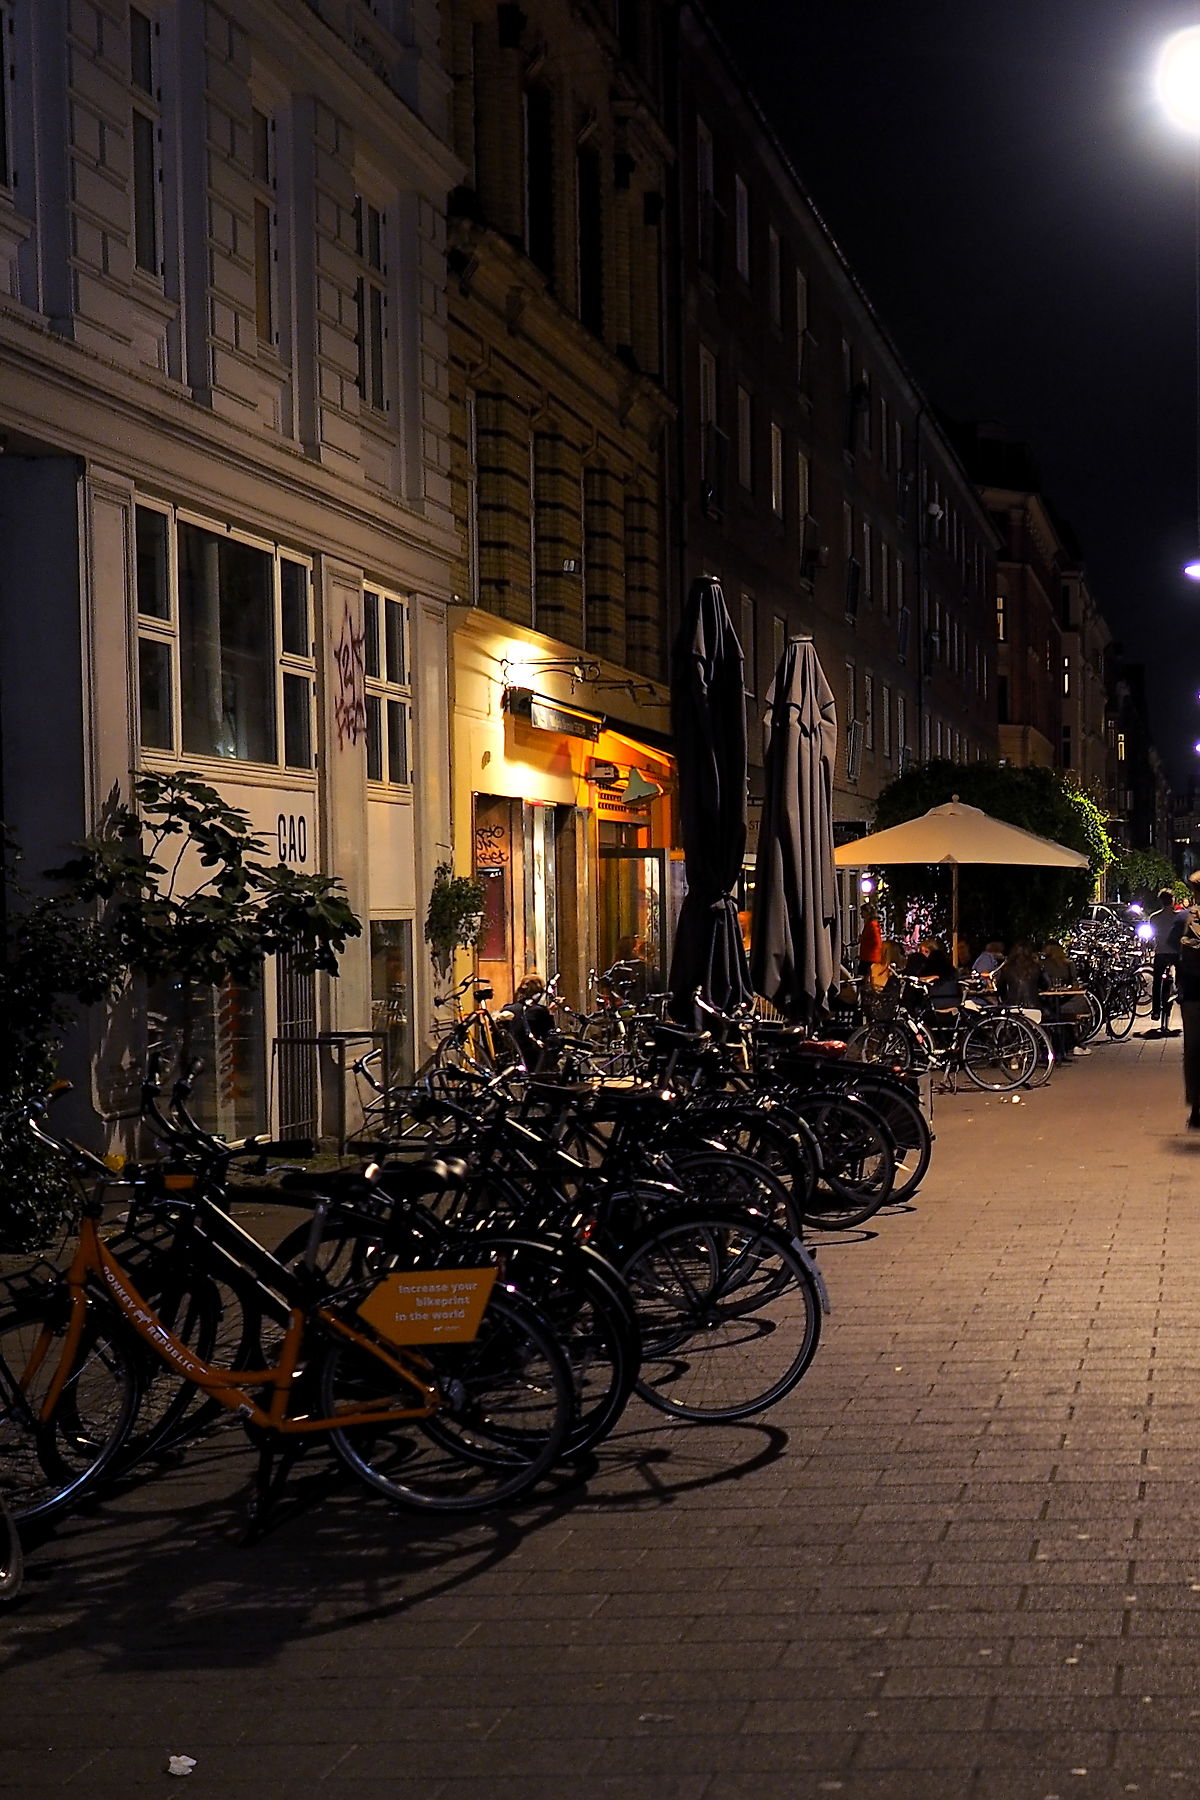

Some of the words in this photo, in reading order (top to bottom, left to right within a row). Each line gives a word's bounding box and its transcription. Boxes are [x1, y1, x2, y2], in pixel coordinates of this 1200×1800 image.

[398, 1282, 449, 1294] Increase
[450, 1281, 479, 1293] your
[415, 1295, 471, 1308] bikeprint
[102, 1265, 137, 1310] DONKEY
[146, 1325, 196, 1372] REPUBLIC
[394, 1312, 407, 1322] in
[409, 1310, 430, 1321] the
[431, 1308, 466, 1320] world
